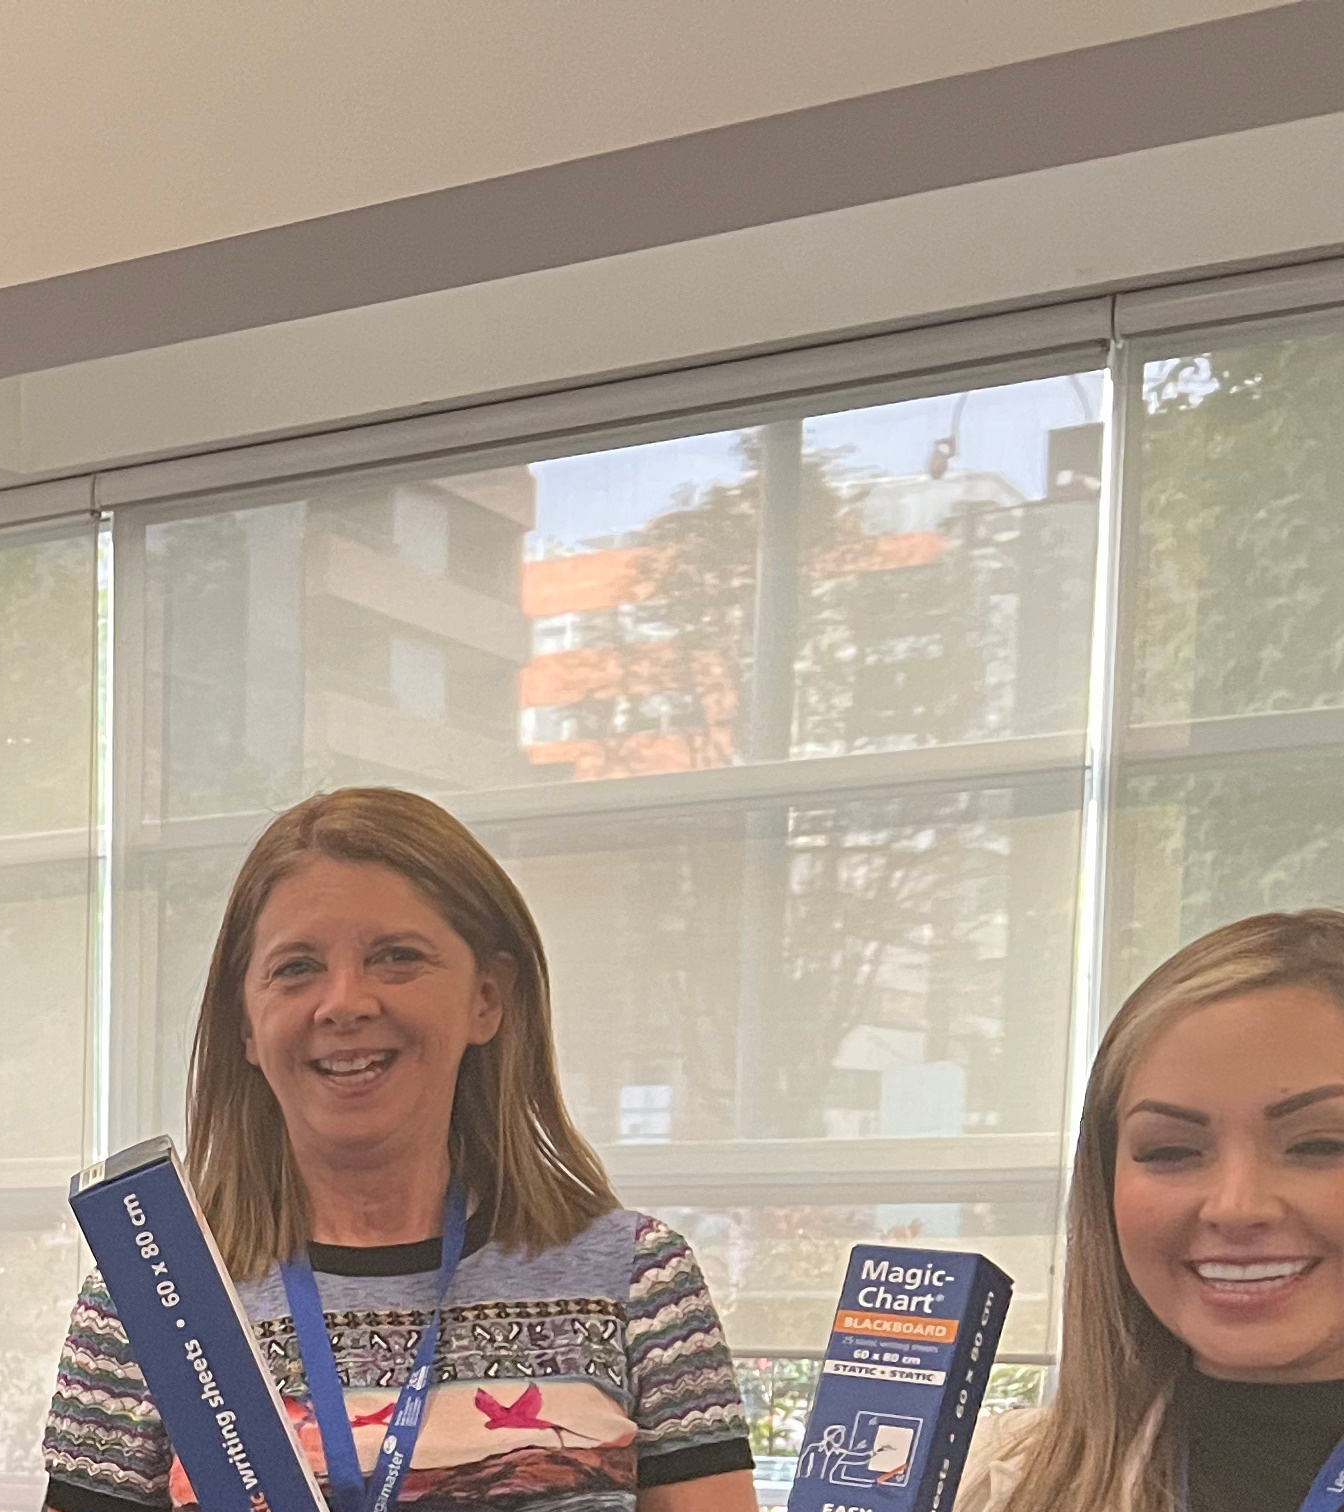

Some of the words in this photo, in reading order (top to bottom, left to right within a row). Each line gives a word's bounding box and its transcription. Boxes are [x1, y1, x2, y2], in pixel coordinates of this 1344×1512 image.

[123, 1193, 146, 1227] cm
[135, 1231, 159, 1260] 80
[151, 1261, 168, 1277] x
[860, 1259, 955, 1290] Magic-
[156, 1280, 180, 1308] 60
[844, 1316, 947, 1337] BLACKBOARD
[853, 1349, 870, 1360] 60
[902, 1356, 921, 1365] cm
[184, 1338, 224, 1413] sheets
[833, 1362, 877, 1376] STATIC
[890, 1368, 934, 1382] STATIC
[216, 1410, 259, 1490] writing
